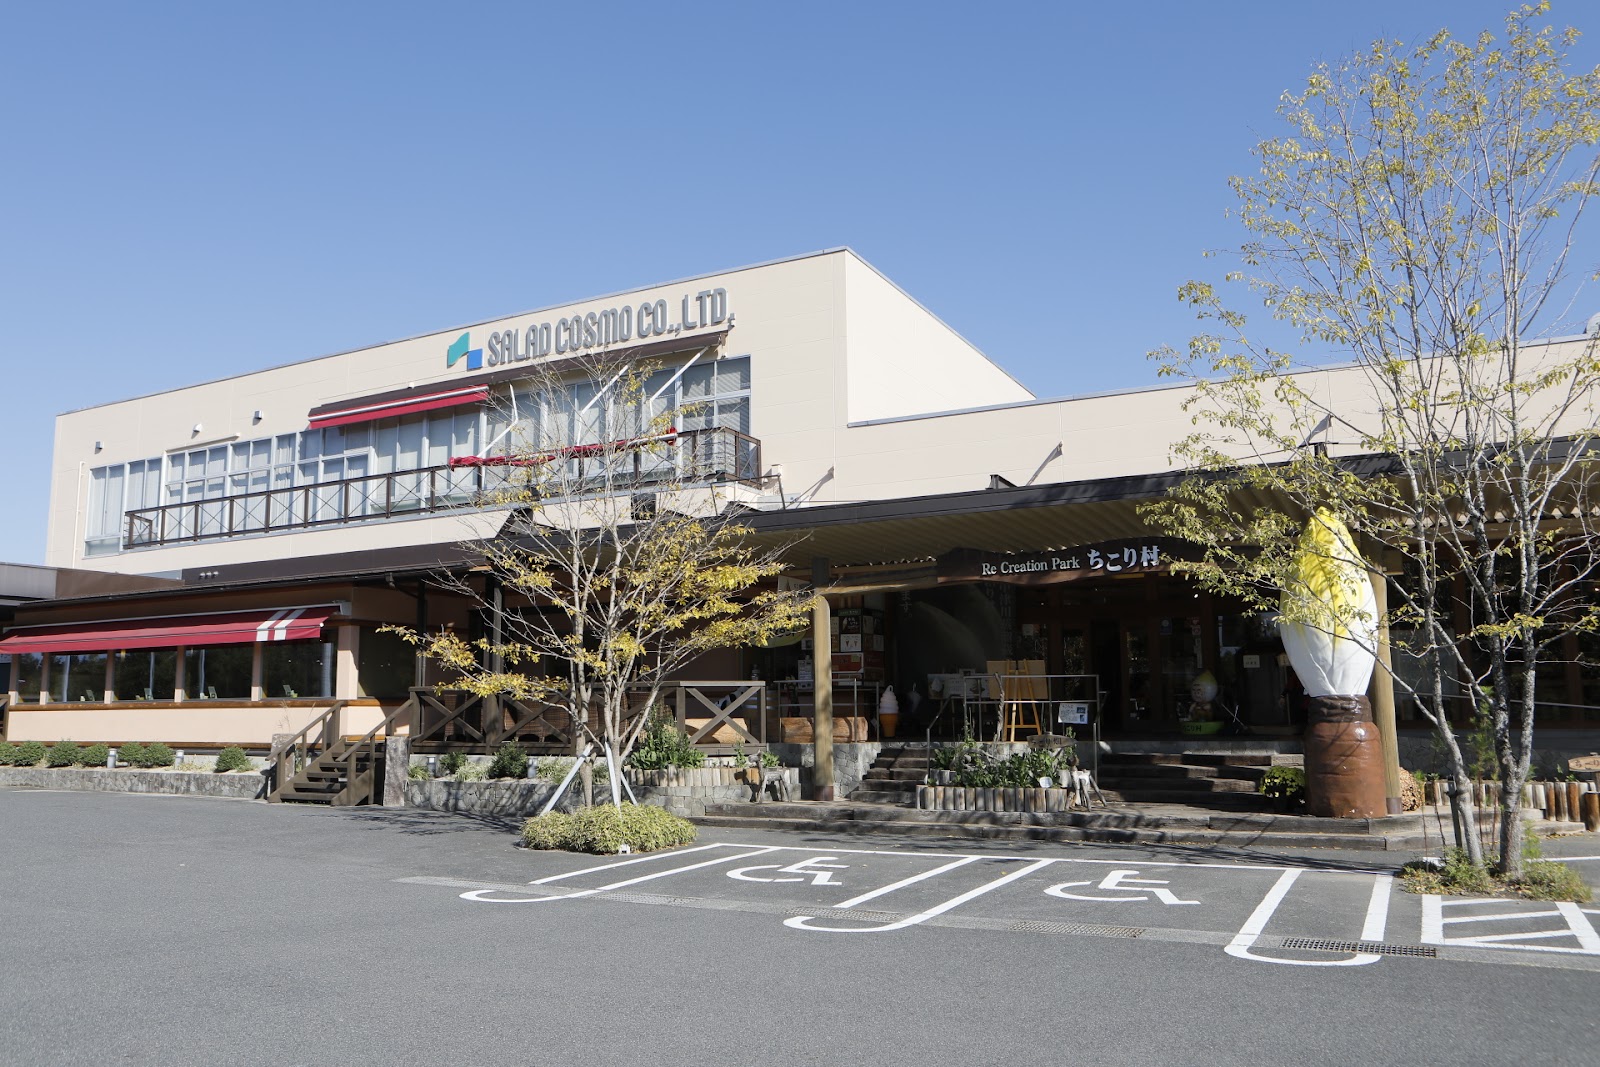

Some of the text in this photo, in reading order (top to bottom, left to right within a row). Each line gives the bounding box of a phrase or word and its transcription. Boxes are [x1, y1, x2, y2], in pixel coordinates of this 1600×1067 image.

[487, 322, 552, 367] SALAD
[554, 305, 633, 354] COSMO
[982, 556, 1081, 576] Re Creation Park
[1086, 545, 1161, 572] ちこり村
